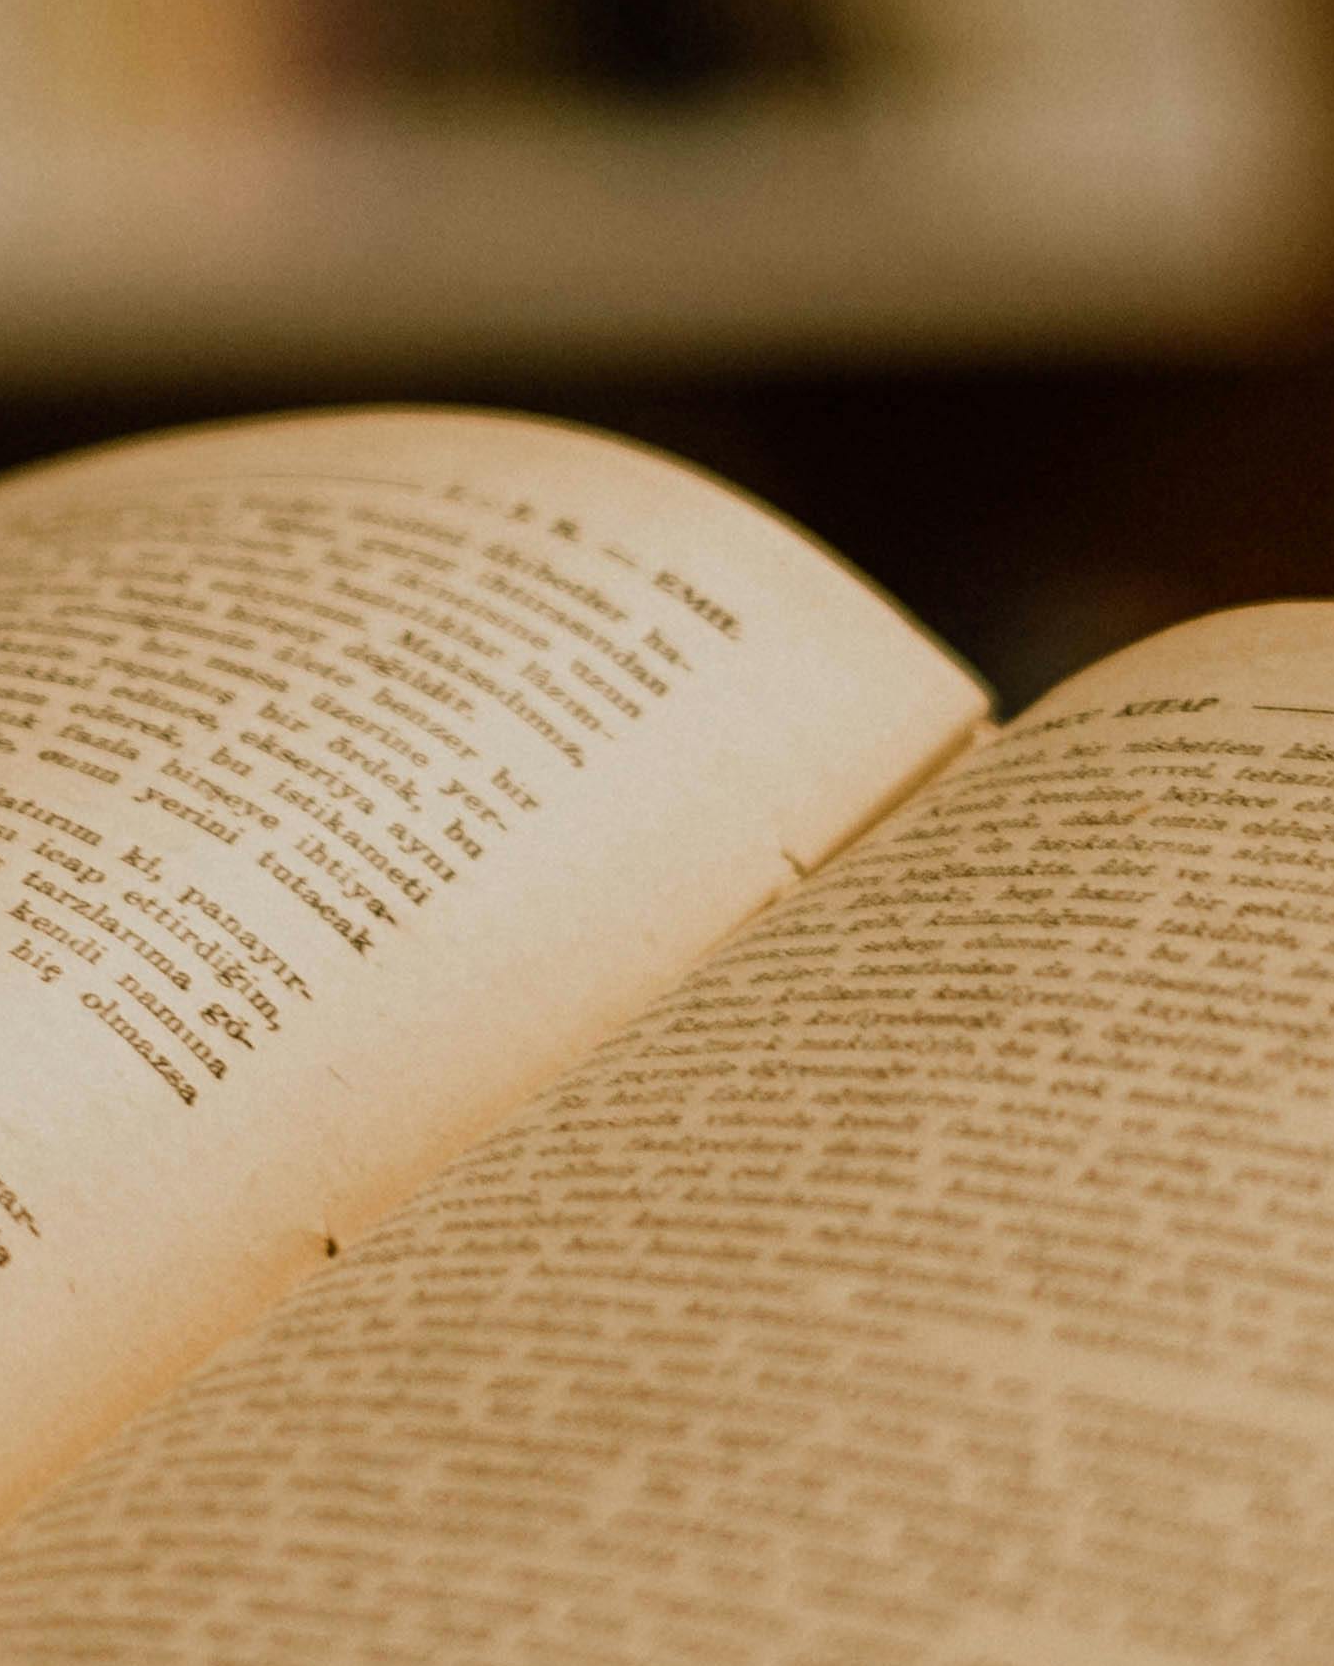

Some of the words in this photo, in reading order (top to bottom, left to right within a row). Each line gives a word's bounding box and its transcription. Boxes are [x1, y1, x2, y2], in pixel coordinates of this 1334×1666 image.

[208, 746, 255, 778] bu
[272, 779, 433, 906] istikameti
[239, 733, 374, 814] ekseriya
[444, 819, 483, 859] bu
[490, 767, 539, 809] bir
[33, 840, 105, 884] icap
[119, 845, 164, 883] ki,
[176, 886, 313, 1001] panayır-
[132, 788, 244, 844] yerini
[257, 852, 374, 955] tutacak
[295, 835, 398, 925] ihtiya-
[6, 900, 109, 965] kendi
[115, 974, 227, 1080] namına
[8, 940, 63, 982] hiç
[80, 992, 198, 1107] olmazsa
[21, 871, 193, 992] tarzlarıma
[199, 1003, 255, 1049] gö-
